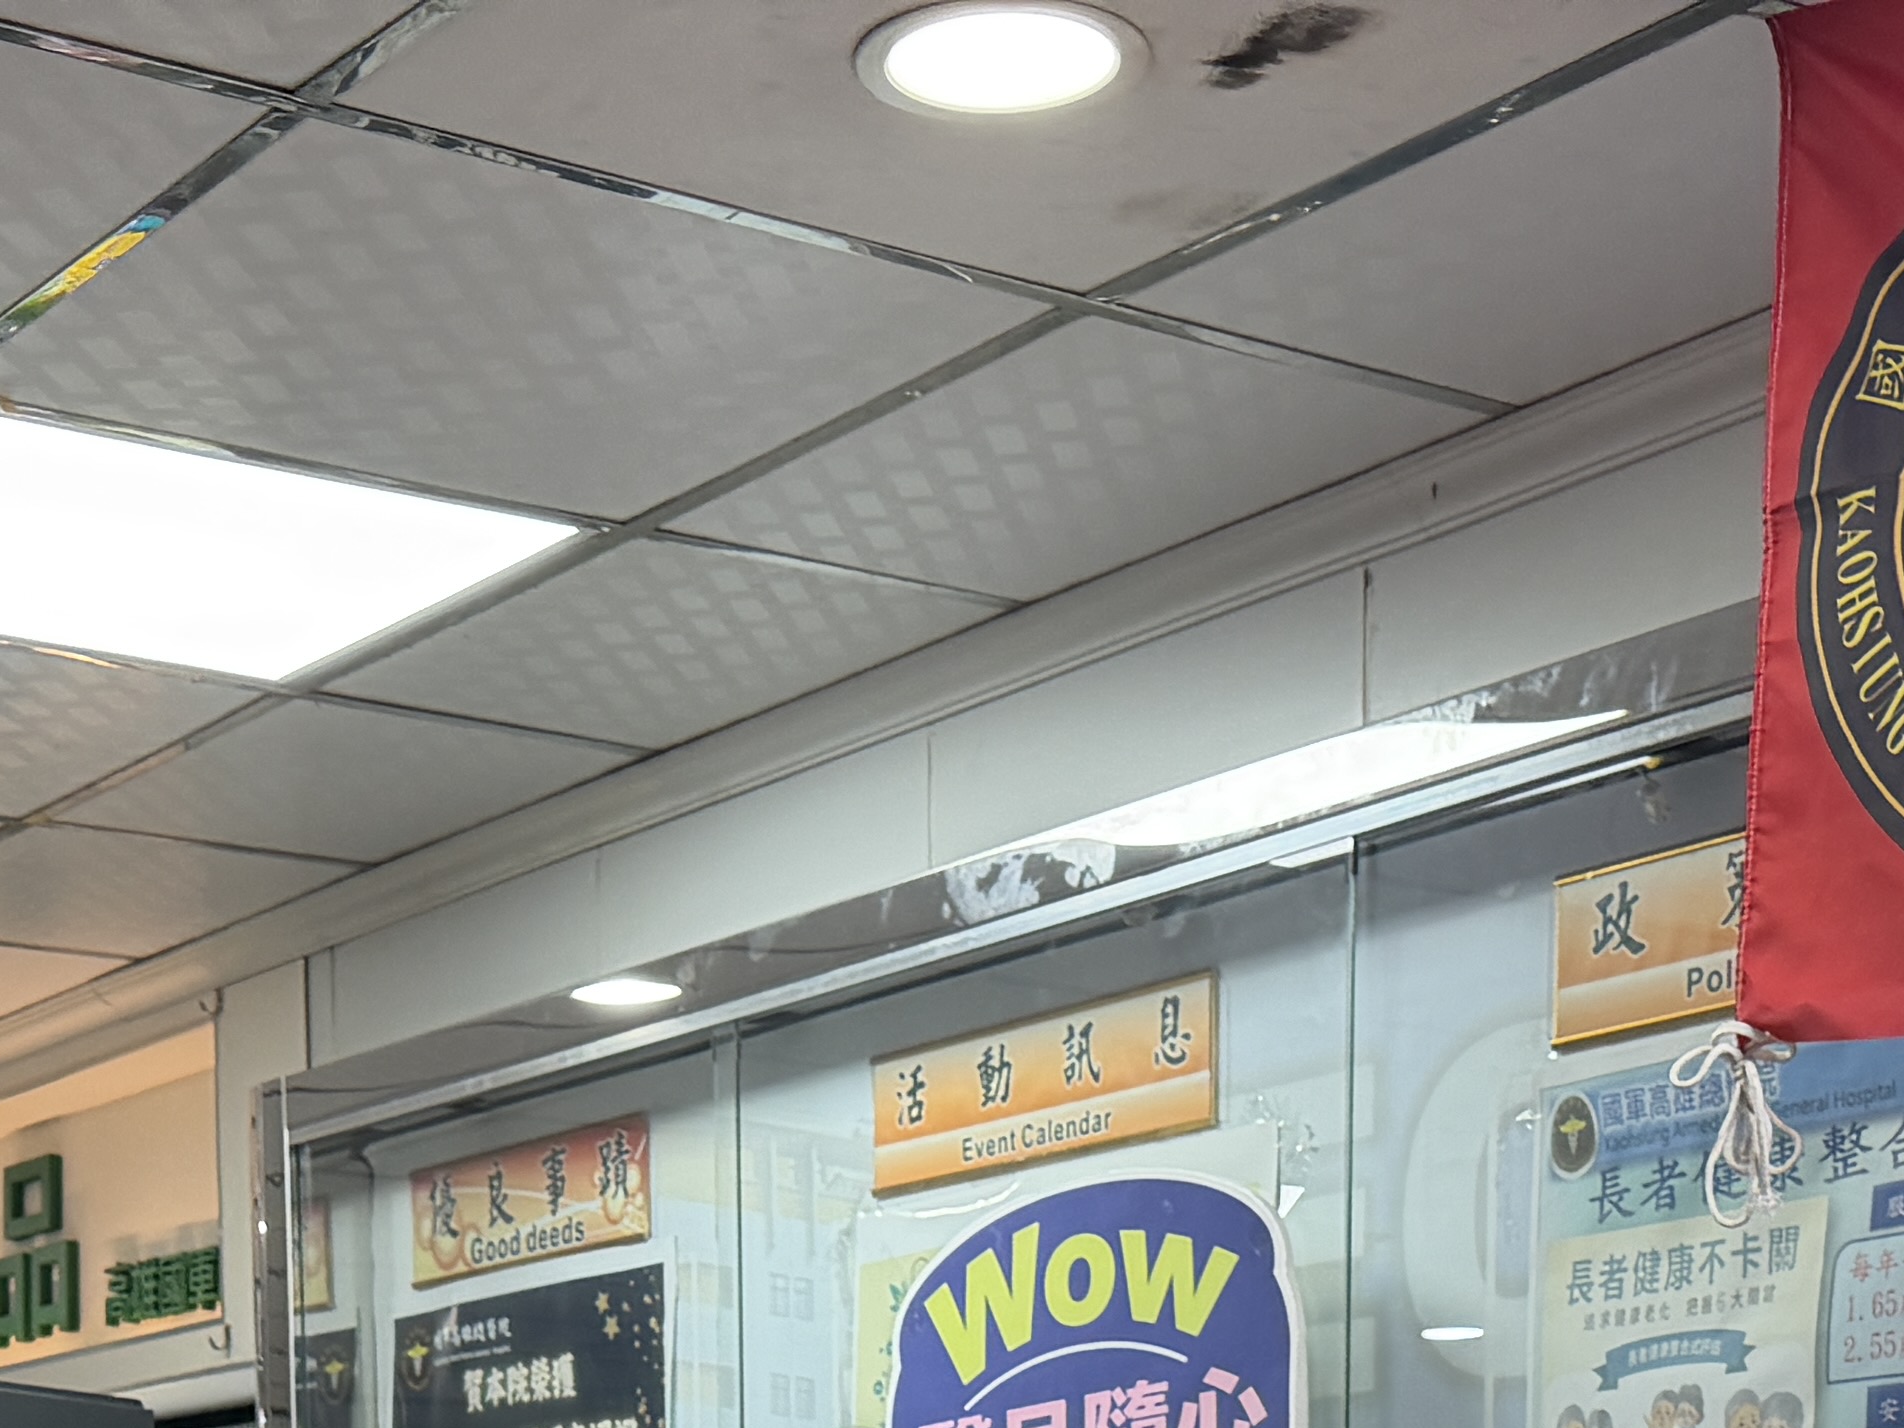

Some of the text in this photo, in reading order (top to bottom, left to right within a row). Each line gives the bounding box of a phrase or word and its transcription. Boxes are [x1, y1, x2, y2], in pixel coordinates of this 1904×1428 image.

[1686, 960, 1734, 998] Pol
[897, 996, 1193, 1128] 活動訊息
[961, 1109, 1112, 1164] Event Calendar
[429, 1132, 633, 1239] 優良事蹟
[471, 1219, 585, 1264] Good deeds
[1566, 1225, 1800, 1305] 長者健康不卡關
[924, 1222, 1240, 1386] WOW
